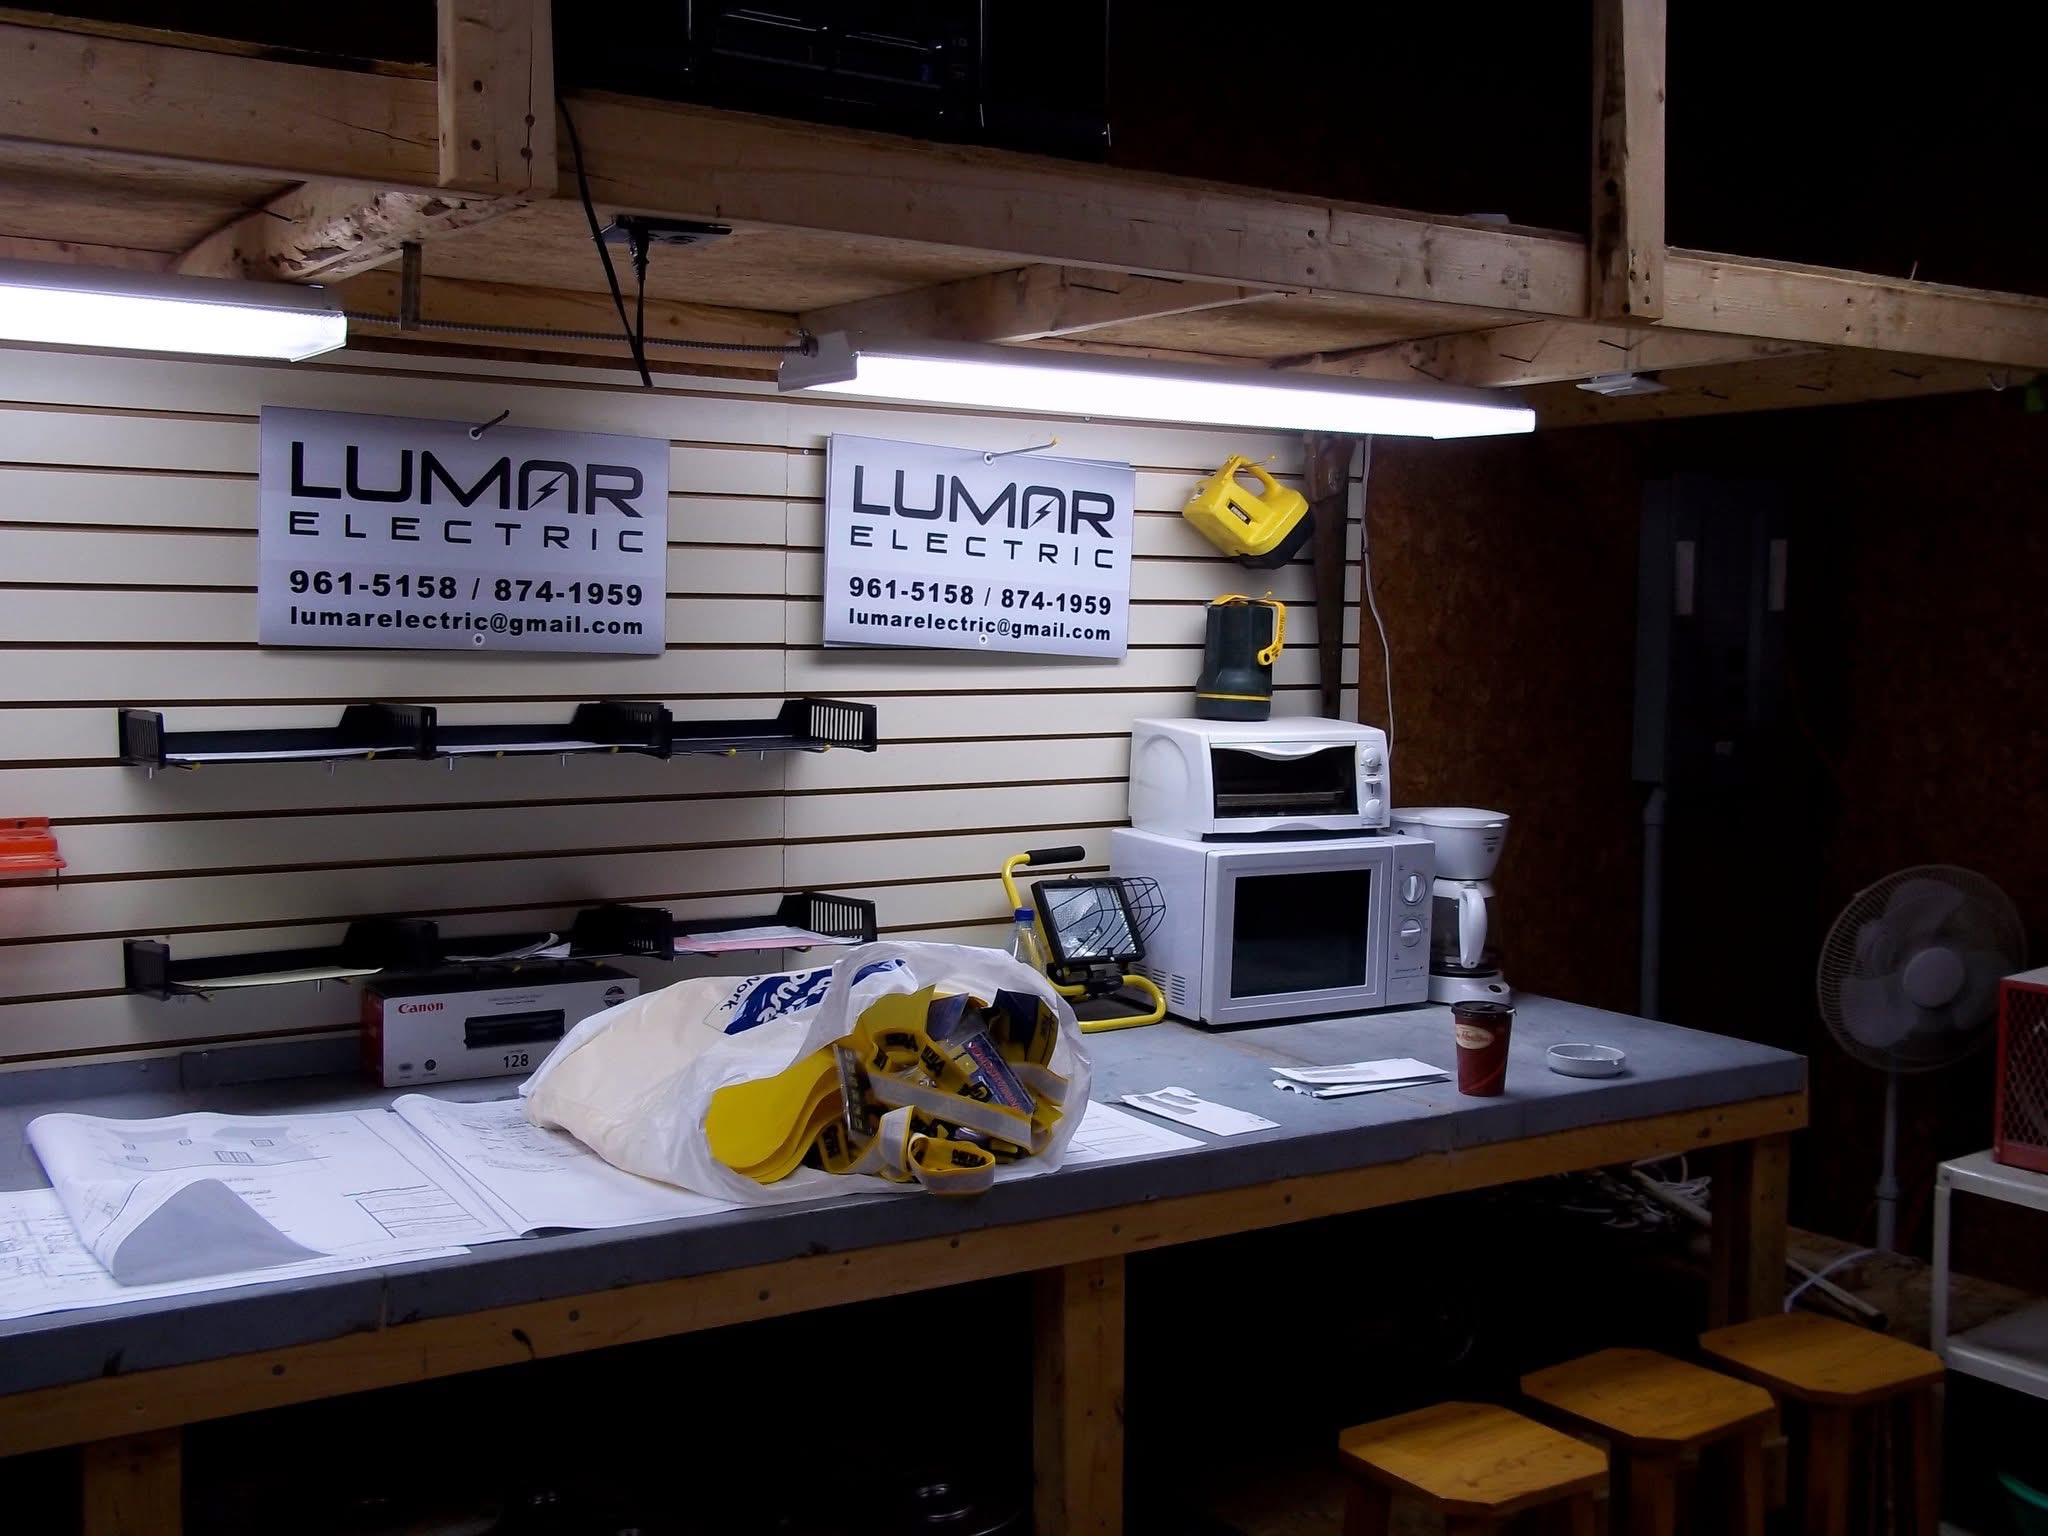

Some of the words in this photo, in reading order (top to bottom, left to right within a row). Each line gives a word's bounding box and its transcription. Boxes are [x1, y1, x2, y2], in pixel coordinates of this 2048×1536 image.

[291, 441, 643, 518] LUMAR
[853, 465, 1115, 538] LUMAR
[289, 511, 644, 553] ELECTRIC
[850, 525, 1114, 569] ELECTRIC
[289, 570, 457, 599] 961-5158
[472, 577, 481, 600] /
[494, 578, 643, 606] 874-1959
[849, 577, 974, 605] 961-5158
[983, 586, 992, 607] /
[1001, 588, 1112, 616] 874-1959
[290, 605, 644, 636] lumarelectric@gmail.com
[849, 608, 1111, 641] lumarelectric@gmail.com
[397, 1001, 444, 1015] Canon
[503, 1053, 530, 1070] 128
